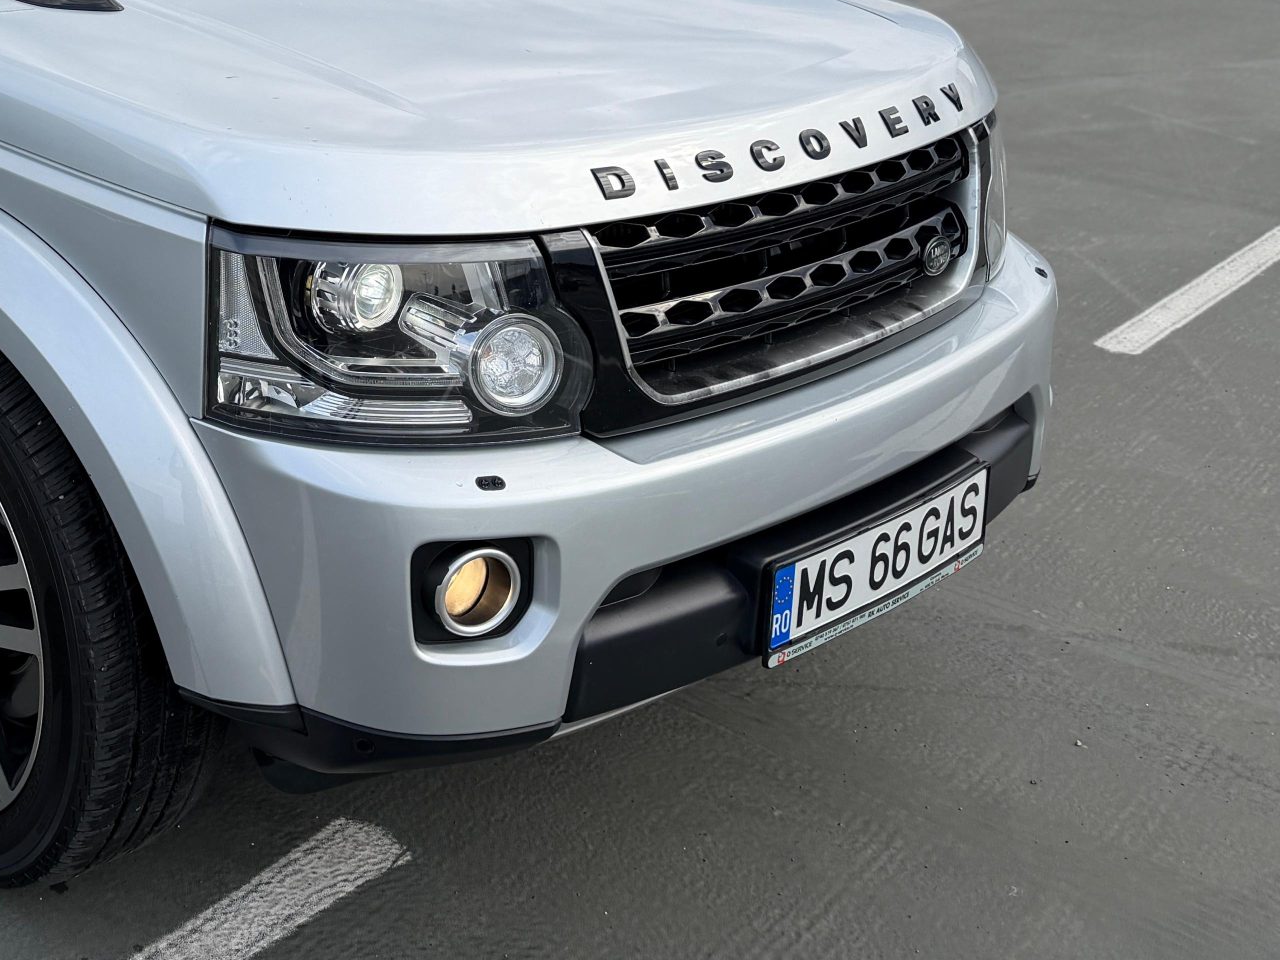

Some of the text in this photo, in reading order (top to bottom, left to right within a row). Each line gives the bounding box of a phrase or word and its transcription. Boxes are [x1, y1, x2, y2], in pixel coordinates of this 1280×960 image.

[590, 83, 963, 200] DISCOVERY
[796, 482, 980, 628] MS 66 GAS
[772, 609, 790, 638] RO
